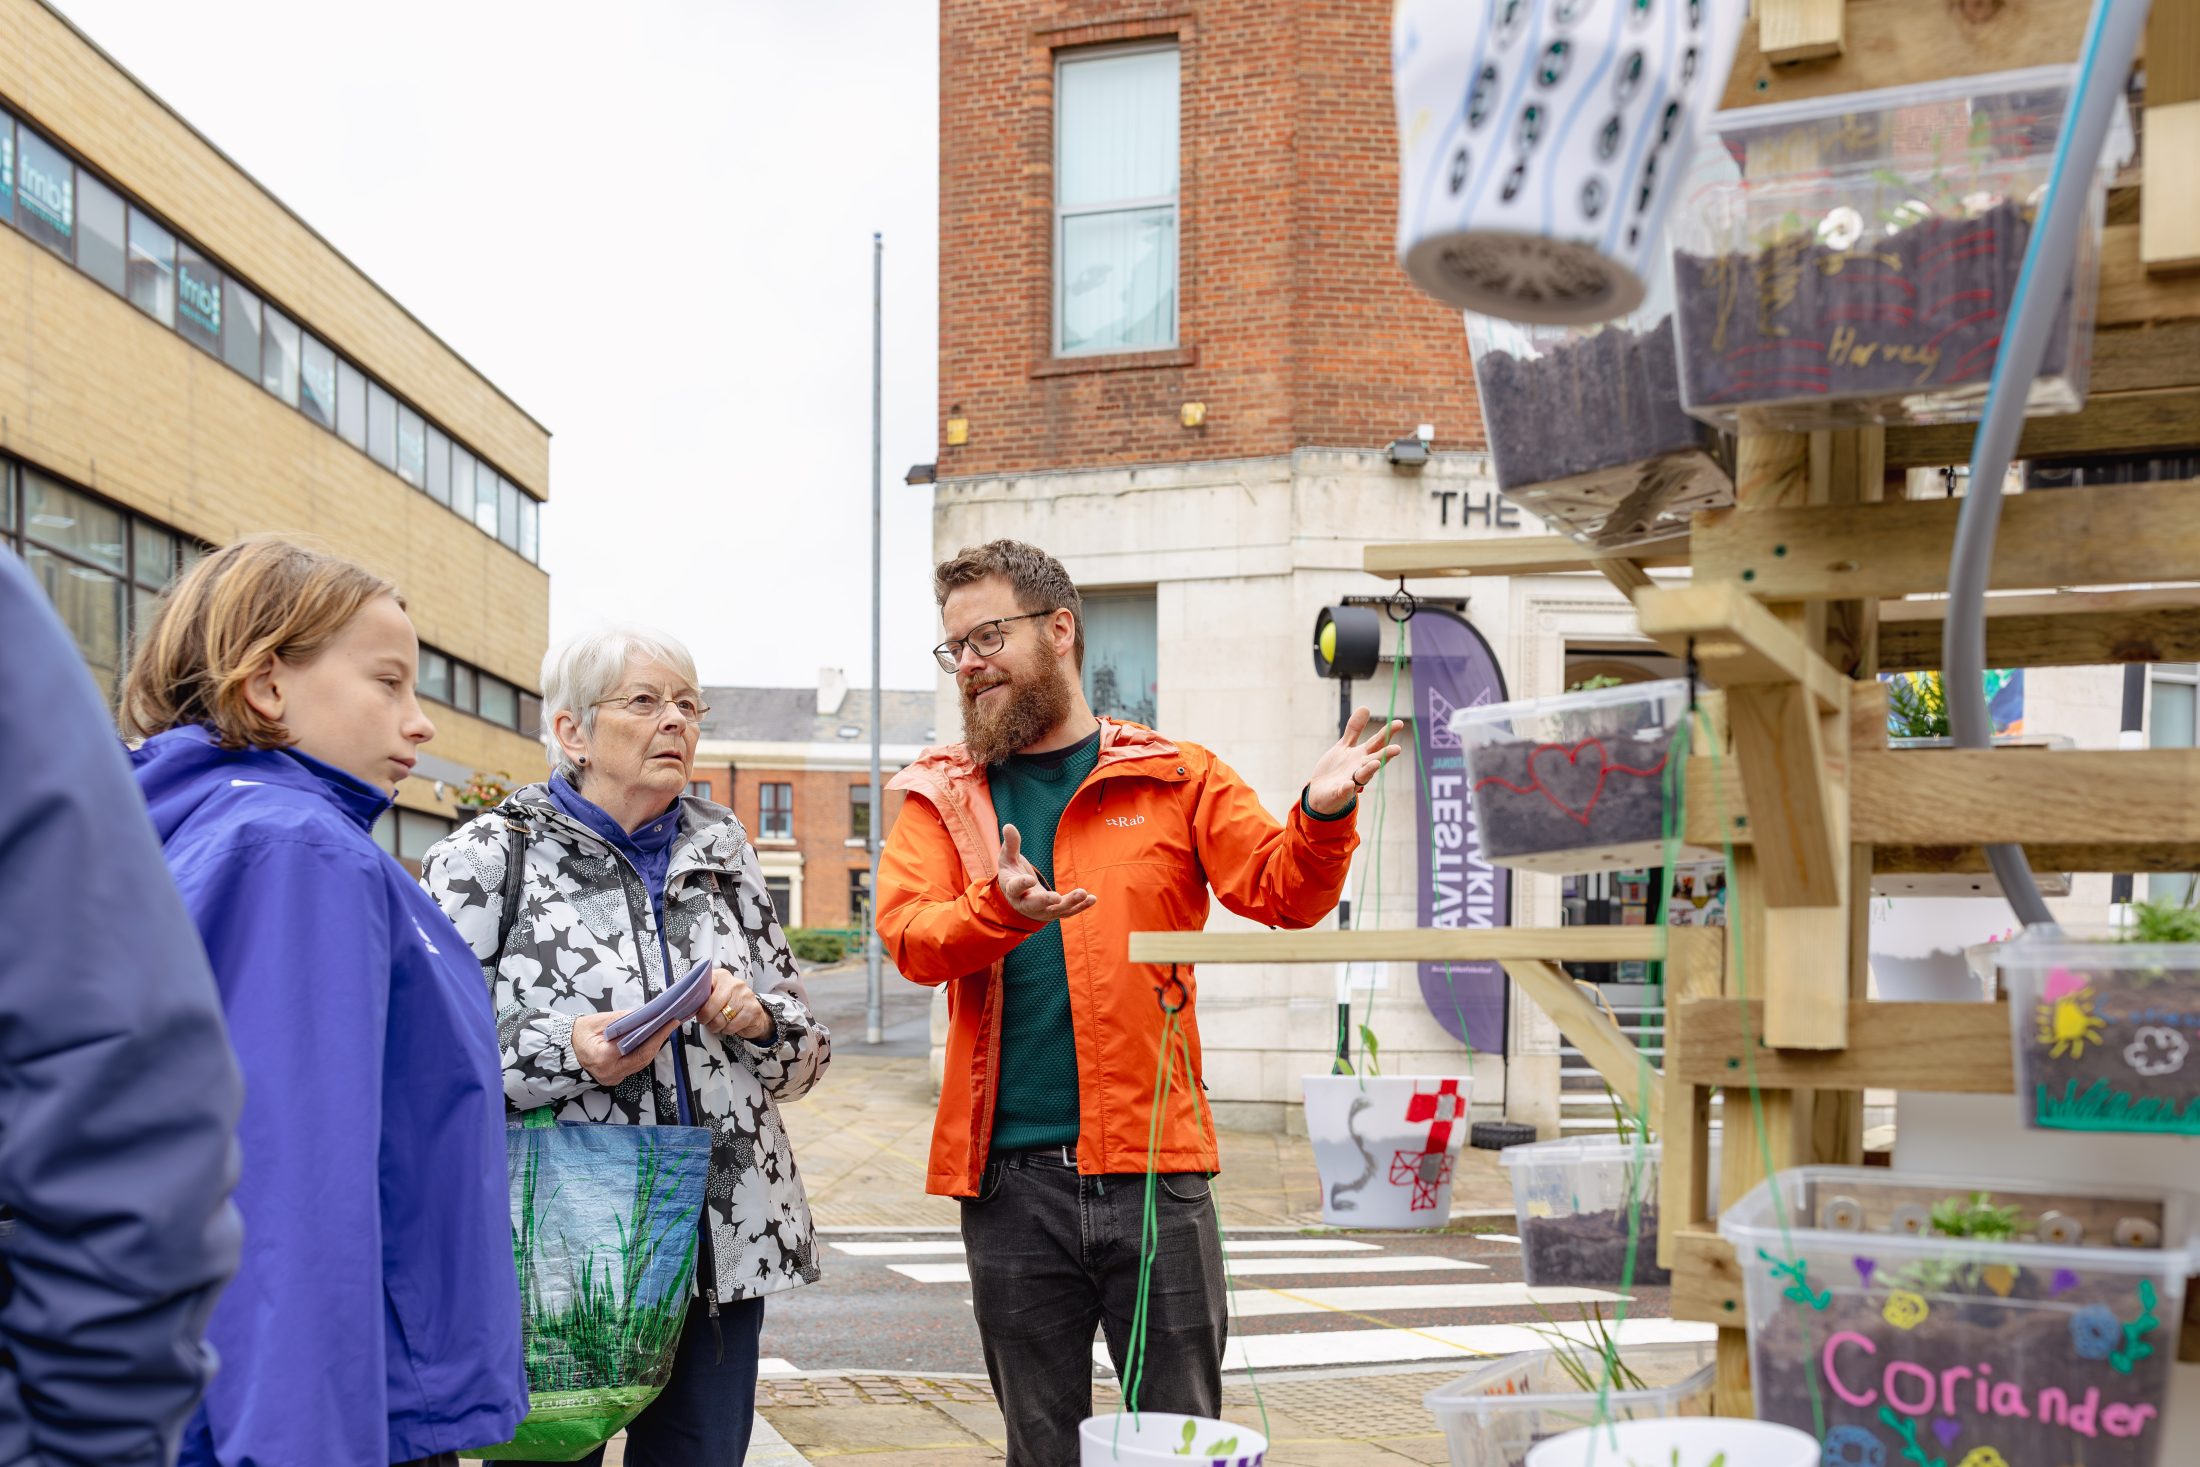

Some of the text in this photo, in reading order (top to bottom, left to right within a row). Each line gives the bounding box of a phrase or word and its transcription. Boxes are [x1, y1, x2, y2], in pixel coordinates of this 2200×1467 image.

[1827, 325, 1941, 386] Harvey
[1431, 490, 1521, 528] THE
[1118, 814, 1145, 827] Rab
[1823, 1331, 2157, 1439] Coriander
